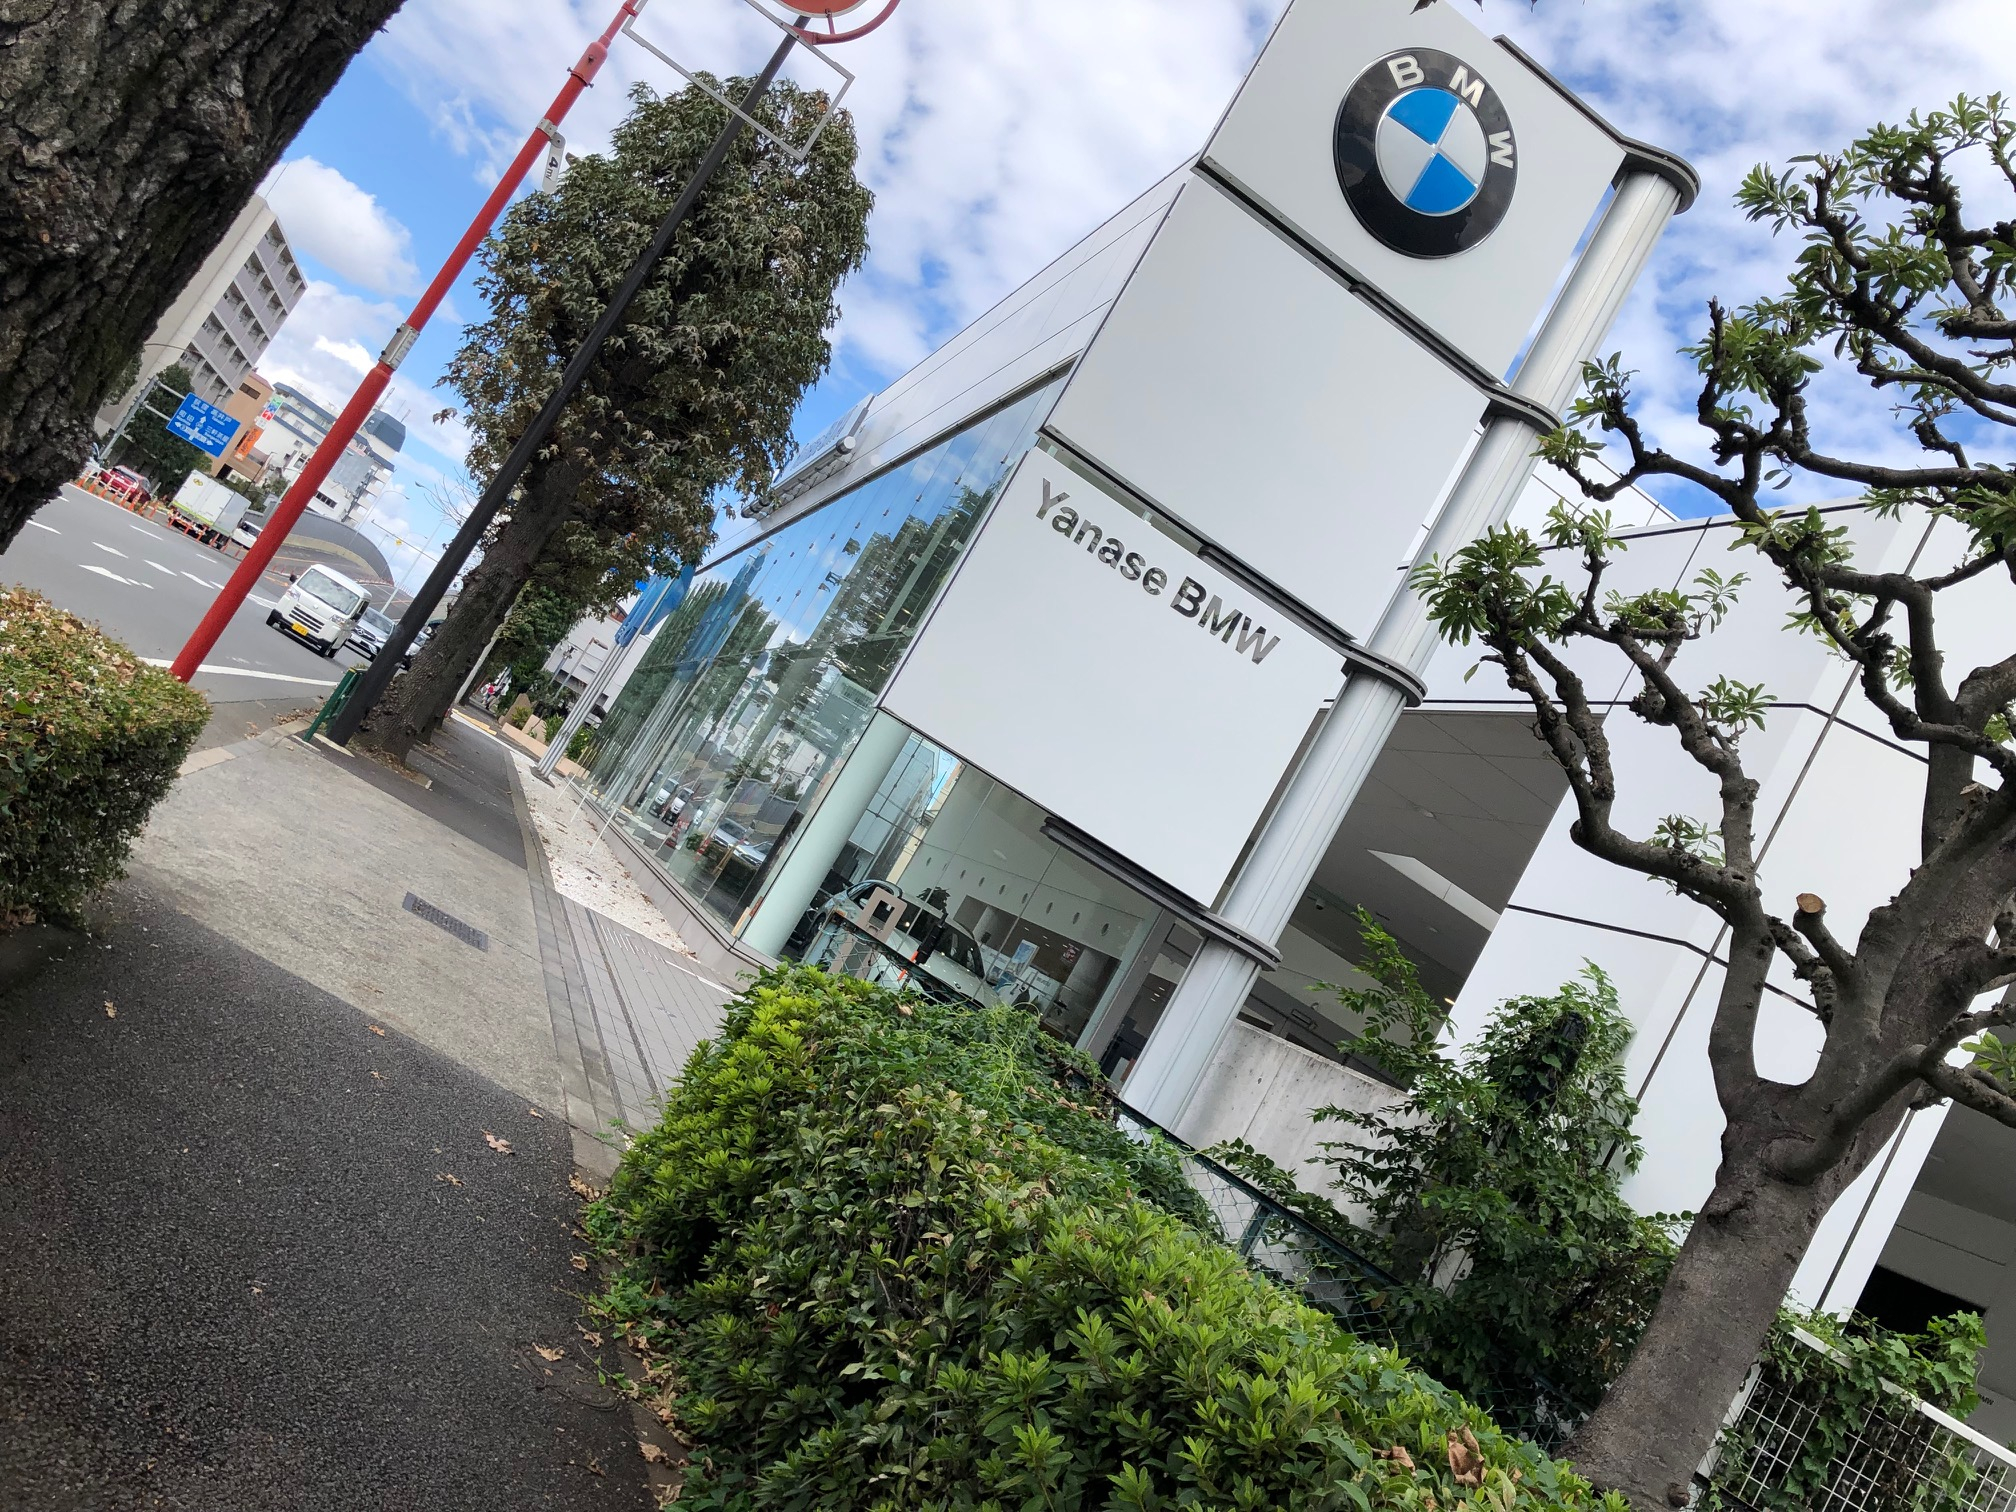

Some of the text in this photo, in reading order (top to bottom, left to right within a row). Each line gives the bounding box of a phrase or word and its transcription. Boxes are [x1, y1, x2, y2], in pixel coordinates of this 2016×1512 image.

[1386, 54, 1515, 170] BMW
[1035, 477, 1281, 665] Yanase BMW
